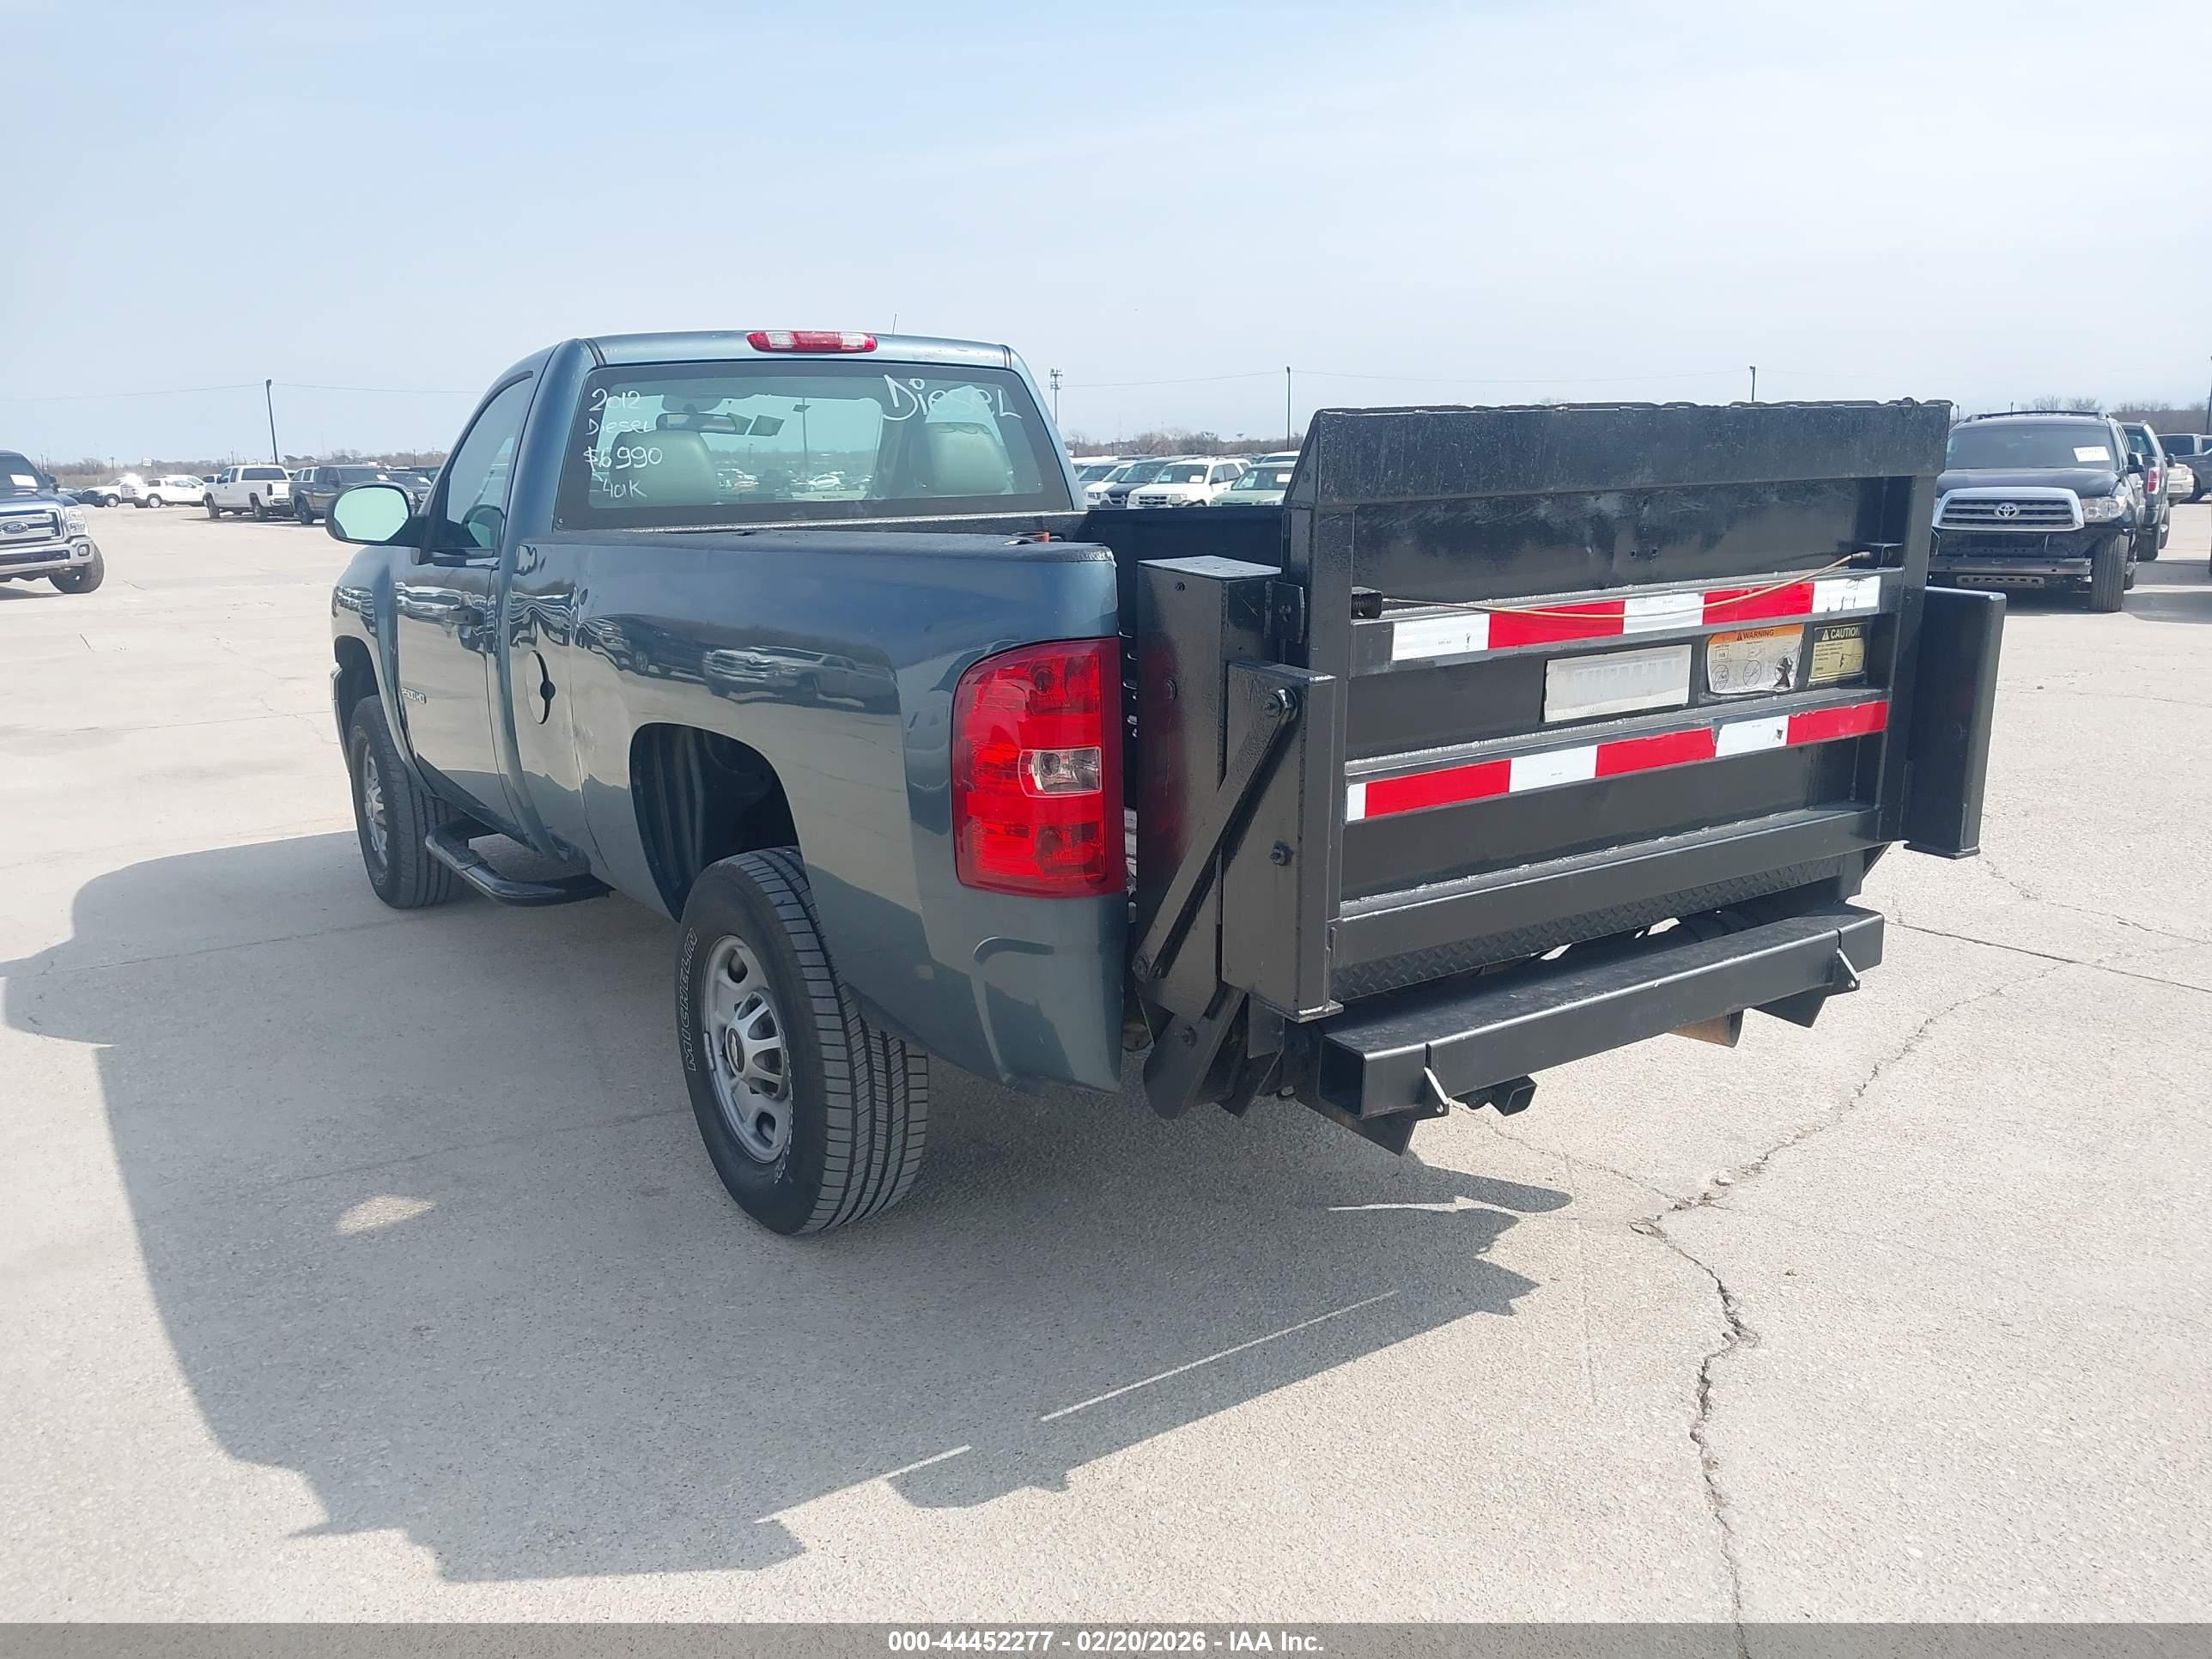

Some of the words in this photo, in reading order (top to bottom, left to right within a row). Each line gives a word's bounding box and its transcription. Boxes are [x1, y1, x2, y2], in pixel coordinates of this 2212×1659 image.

[588, 387, 641, 411] 2012
[1743, 629, 1775, 640] WARNING
[1830, 625, 1862, 640] CAUTION
[679, 927, 698, 1072] MICHELIN
